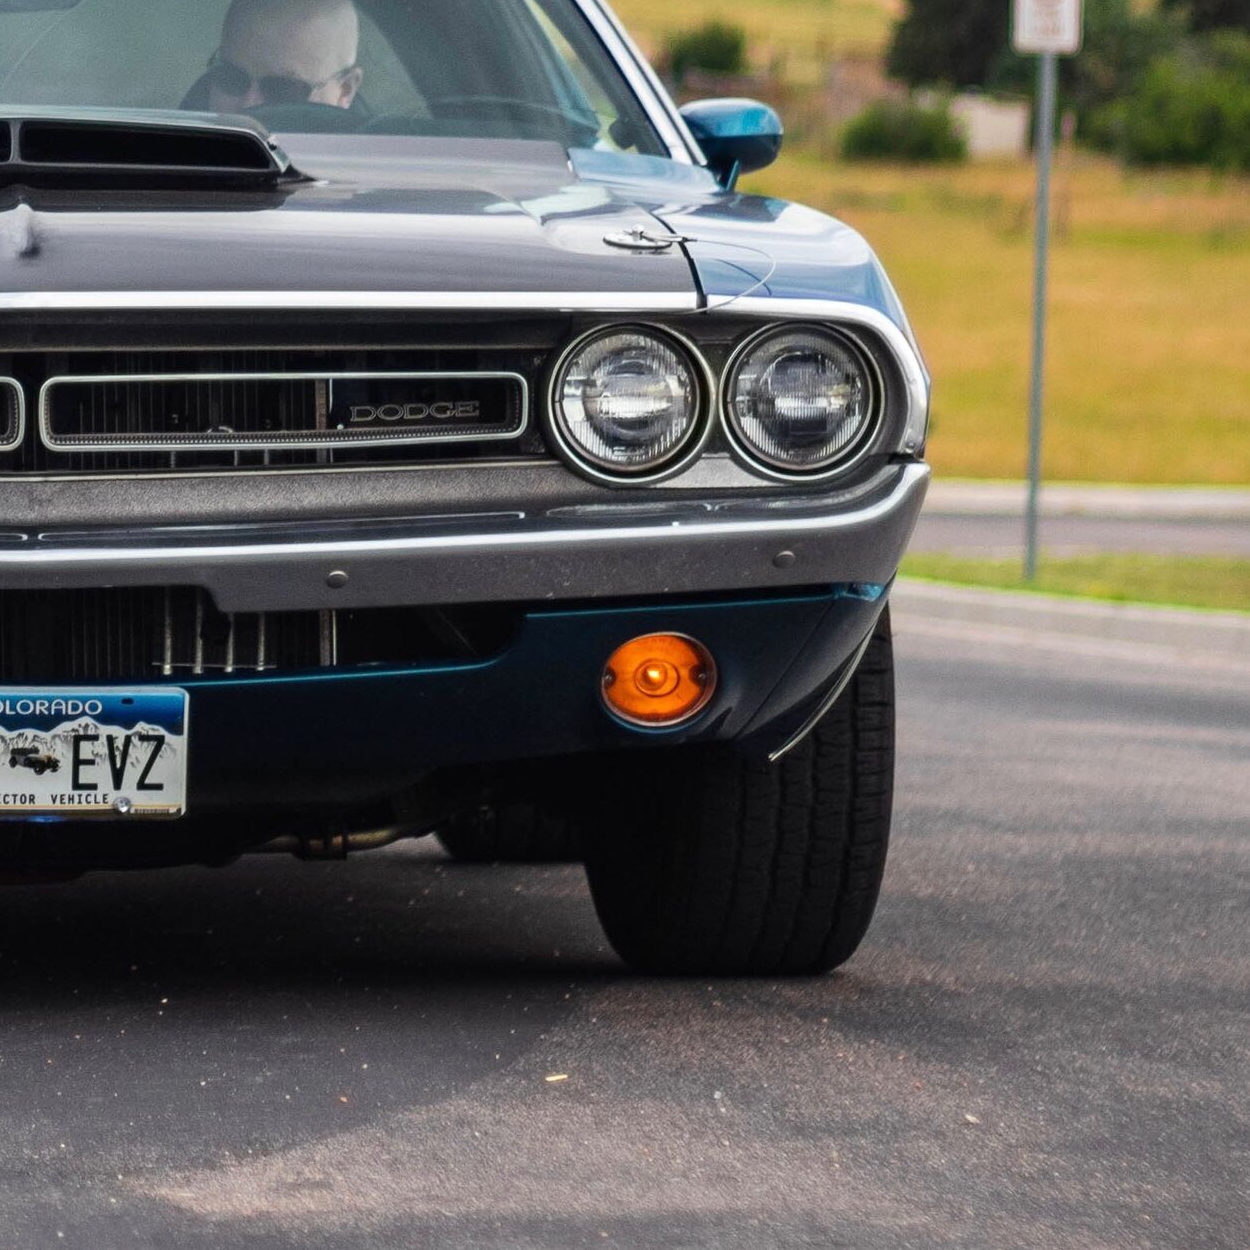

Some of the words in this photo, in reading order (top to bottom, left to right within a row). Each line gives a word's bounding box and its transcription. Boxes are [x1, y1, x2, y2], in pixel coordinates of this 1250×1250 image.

[350, 402, 479, 422] DODGE
[71, 734, 165, 791] EVZ
[50, 793, 109, 805] VEHICLE
